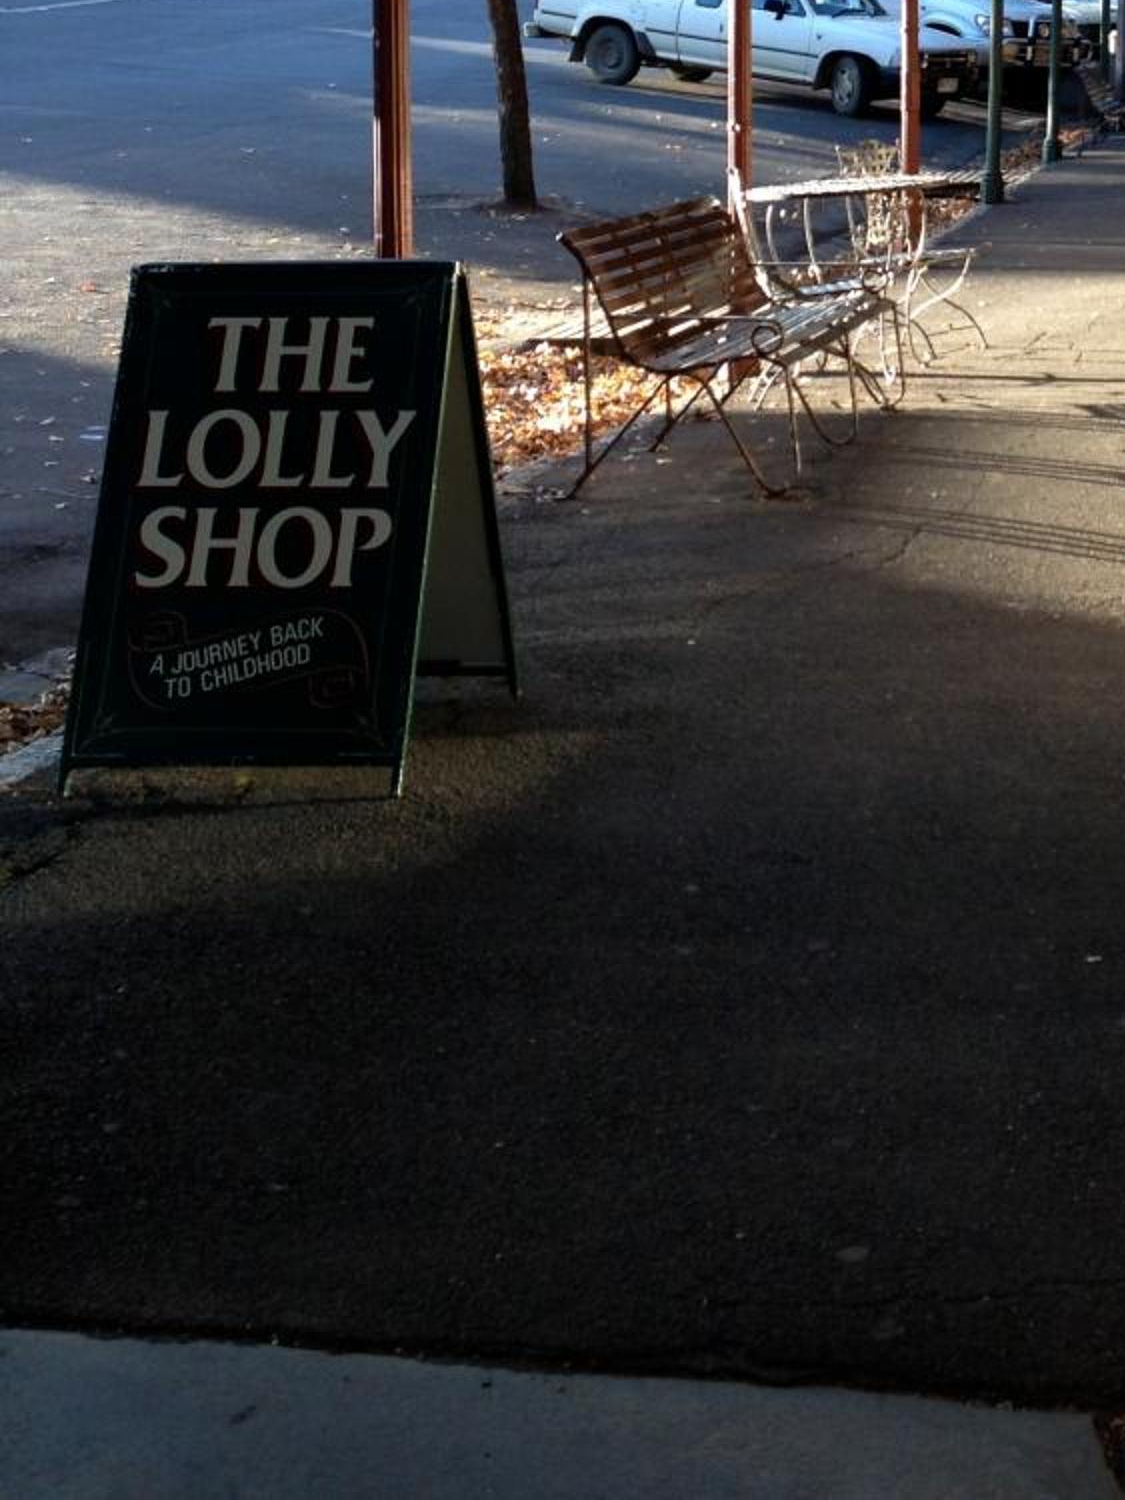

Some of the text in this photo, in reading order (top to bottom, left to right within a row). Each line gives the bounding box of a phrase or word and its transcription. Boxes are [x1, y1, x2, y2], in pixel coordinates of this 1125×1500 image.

[207, 316, 375, 393] THE
[135, 408, 417, 489] LOLLY
[134, 506, 393, 590] SHOP
[148, 614, 326, 677] A JOURNEY BACK
[162, 642, 312, 701] TO CHILDHOOD
